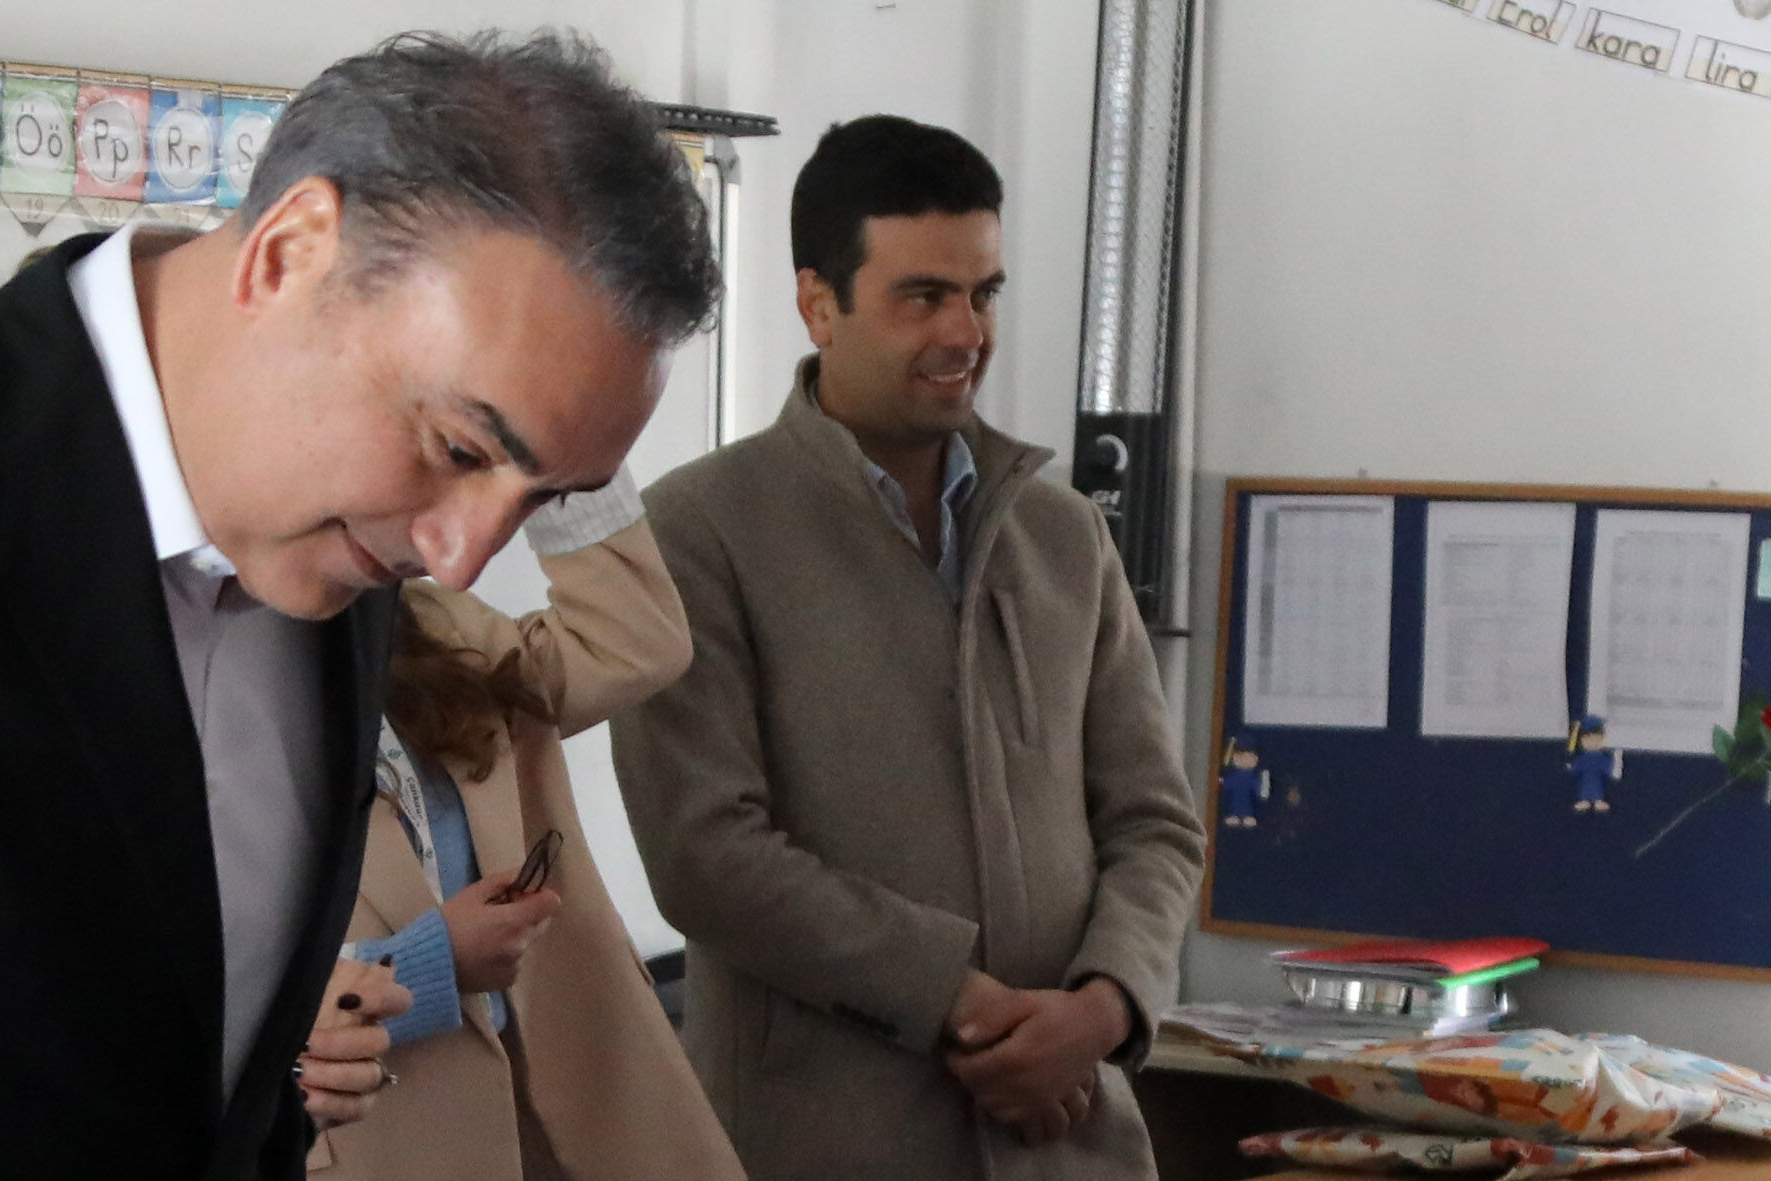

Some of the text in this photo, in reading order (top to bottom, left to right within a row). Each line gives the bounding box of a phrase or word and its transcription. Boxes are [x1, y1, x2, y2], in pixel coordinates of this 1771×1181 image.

[1586, 8, 1662, 69] kara
[1705, 39, 1759, 91] lira
[16, 101, 63, 157] Öö
[93, 118, 129, 179] Pp
[167, 126, 201, 169] Rr
